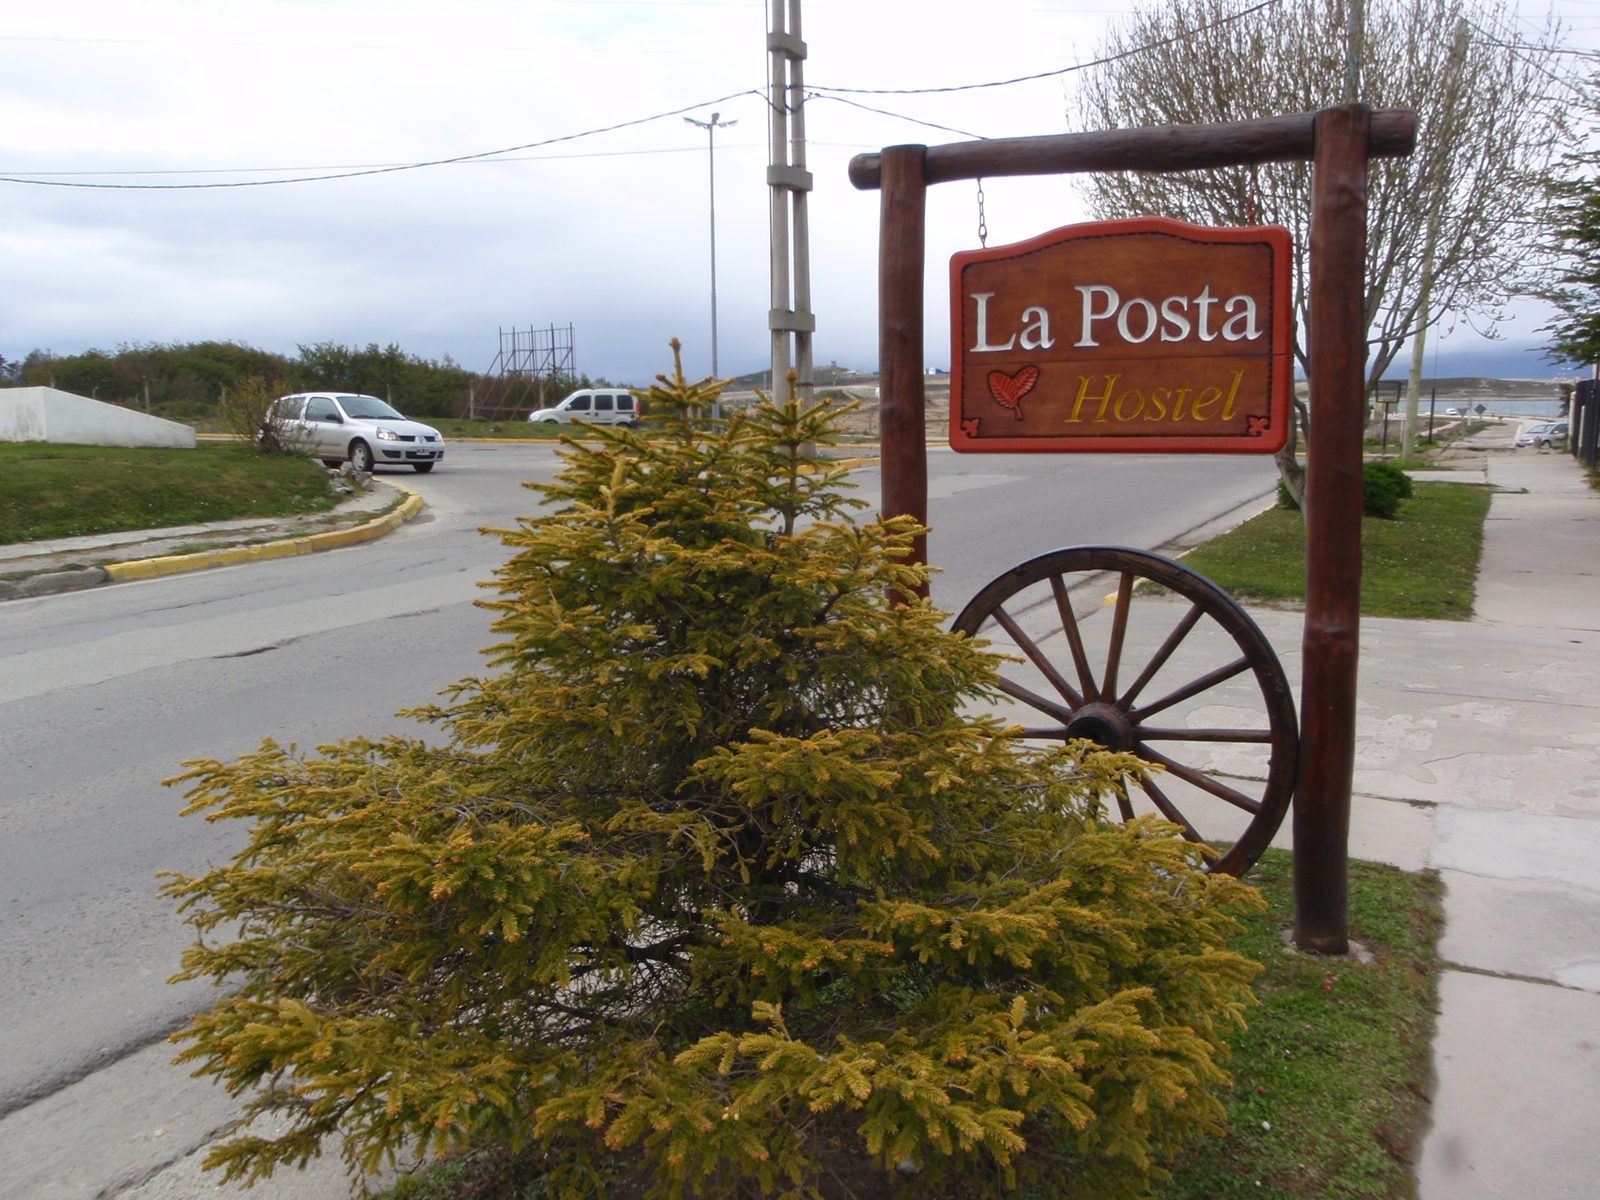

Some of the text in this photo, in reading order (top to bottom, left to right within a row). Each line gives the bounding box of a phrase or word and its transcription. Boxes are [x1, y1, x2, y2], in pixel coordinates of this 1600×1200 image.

[969, 285, 1263, 352] La Posta
[1064, 369, 1245, 423] Hostel
